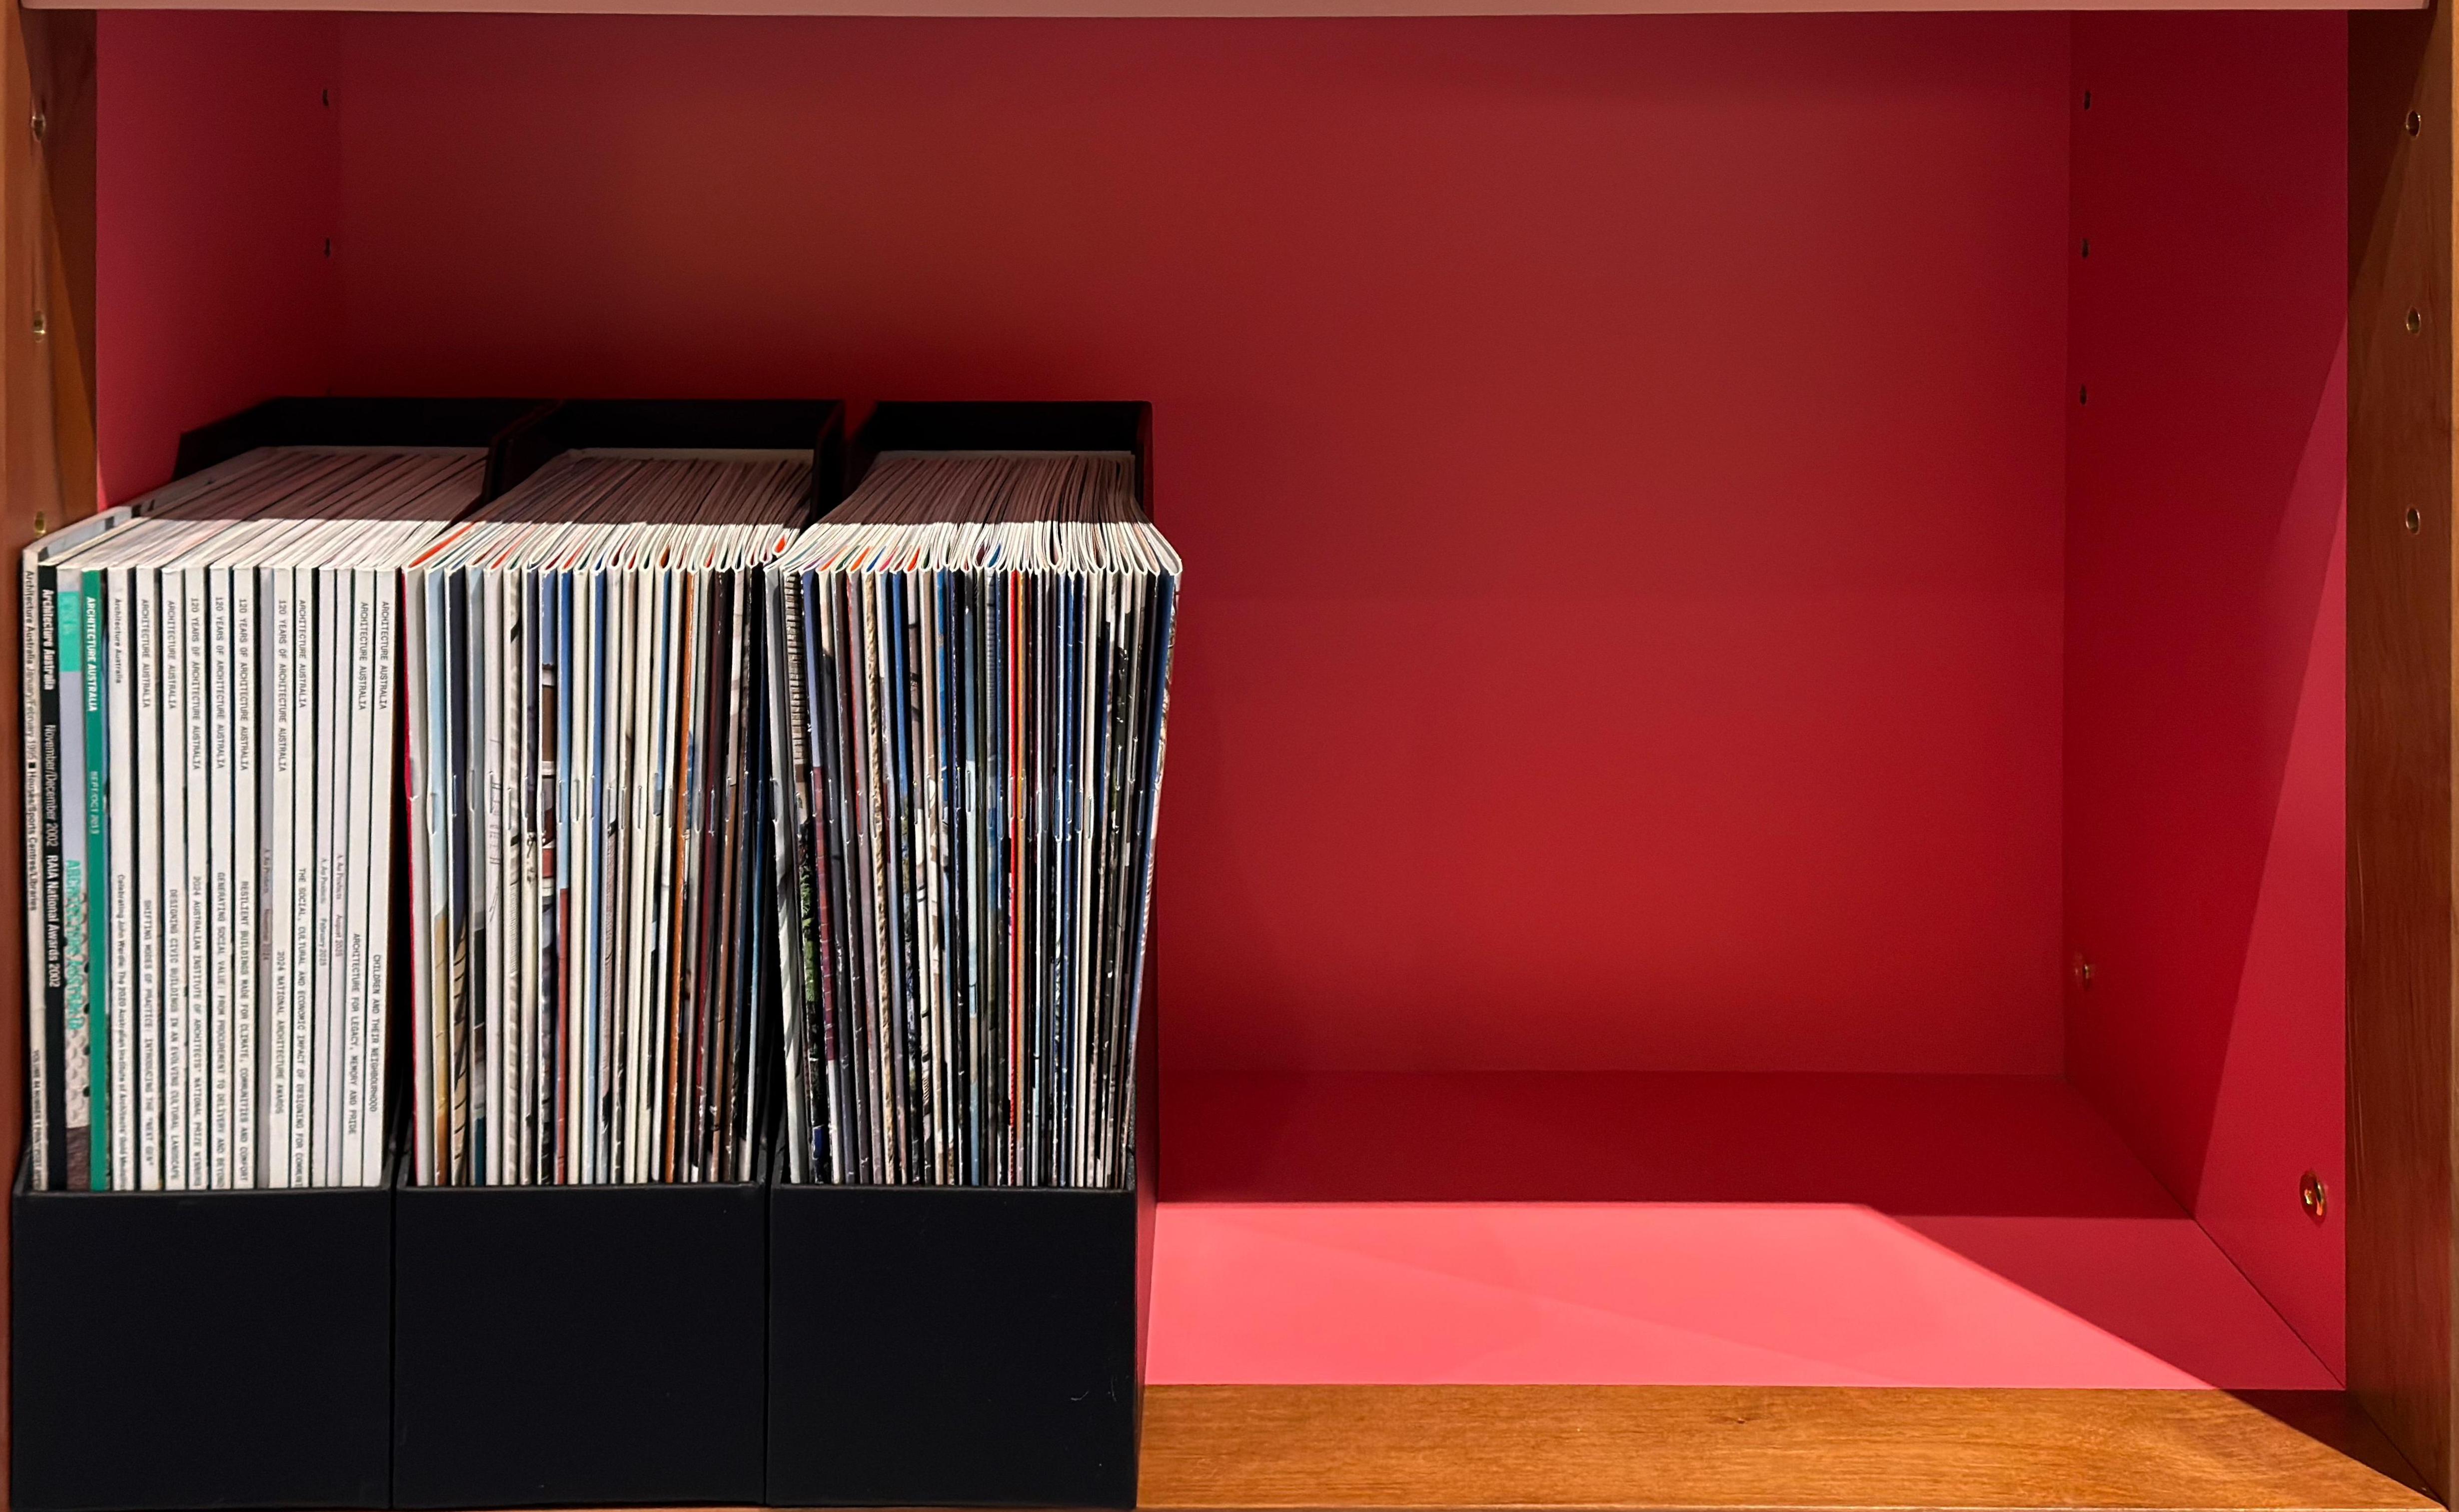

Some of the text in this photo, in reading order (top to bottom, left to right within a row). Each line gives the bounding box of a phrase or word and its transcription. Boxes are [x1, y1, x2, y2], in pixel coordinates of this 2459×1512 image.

[42, 590, 55, 690] Architecture Australia
[87, 597, 97, 711] ARCHITECTURE AUSTRALIA
[192, 647, 199, 656] OF
[216, 646, 223, 655] OF
[240, 648, 247, 657] OF
[279, 649, 286, 658] OF
[45, 725, 60, 987] November/December 2002 RAIA National Awards 2002
[352, 933, 360, 992] ARCHITECTURE
[145, 974, 152, 983] OF
[372, 955, 381, 993] CHILDREN
[194, 1004, 201, 1014] OF
[170, 1018, 178, 1027] IN
[171, 1032, 178, 1042] AN
[297, 1069, 304, 1078] OF
[349, 1056, 358, 1085] MEMORY
[217, 1080, 224, 1089] TO
[369, 1048, 379, 1112] NEIGHBOURHOOD
